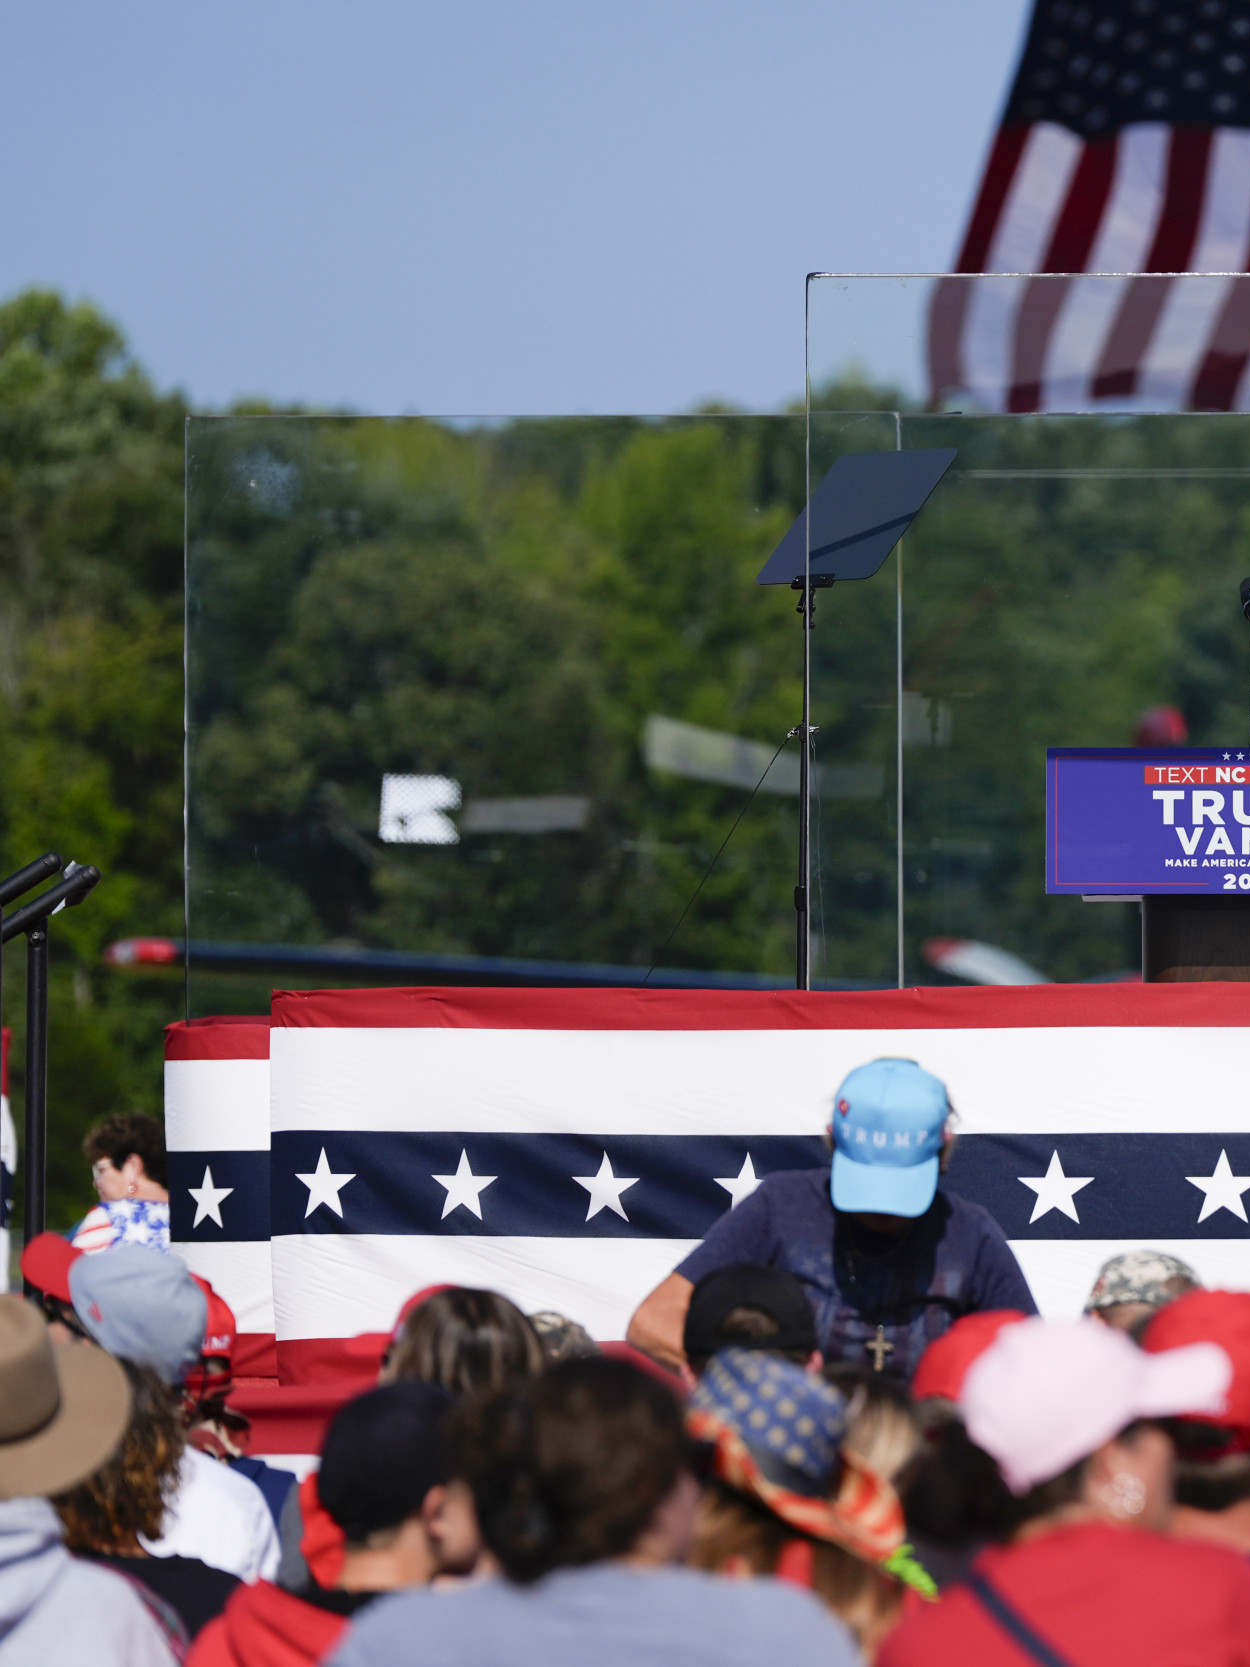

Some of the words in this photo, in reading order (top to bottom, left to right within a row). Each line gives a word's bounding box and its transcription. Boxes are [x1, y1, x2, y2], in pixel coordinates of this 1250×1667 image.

[1154, 767, 1209, 783] TEXT
[1215, 767, 1246, 783] NC
[1164, 858, 1198, 868] MAKE
[842, 1121, 929, 1149] TRUMP
